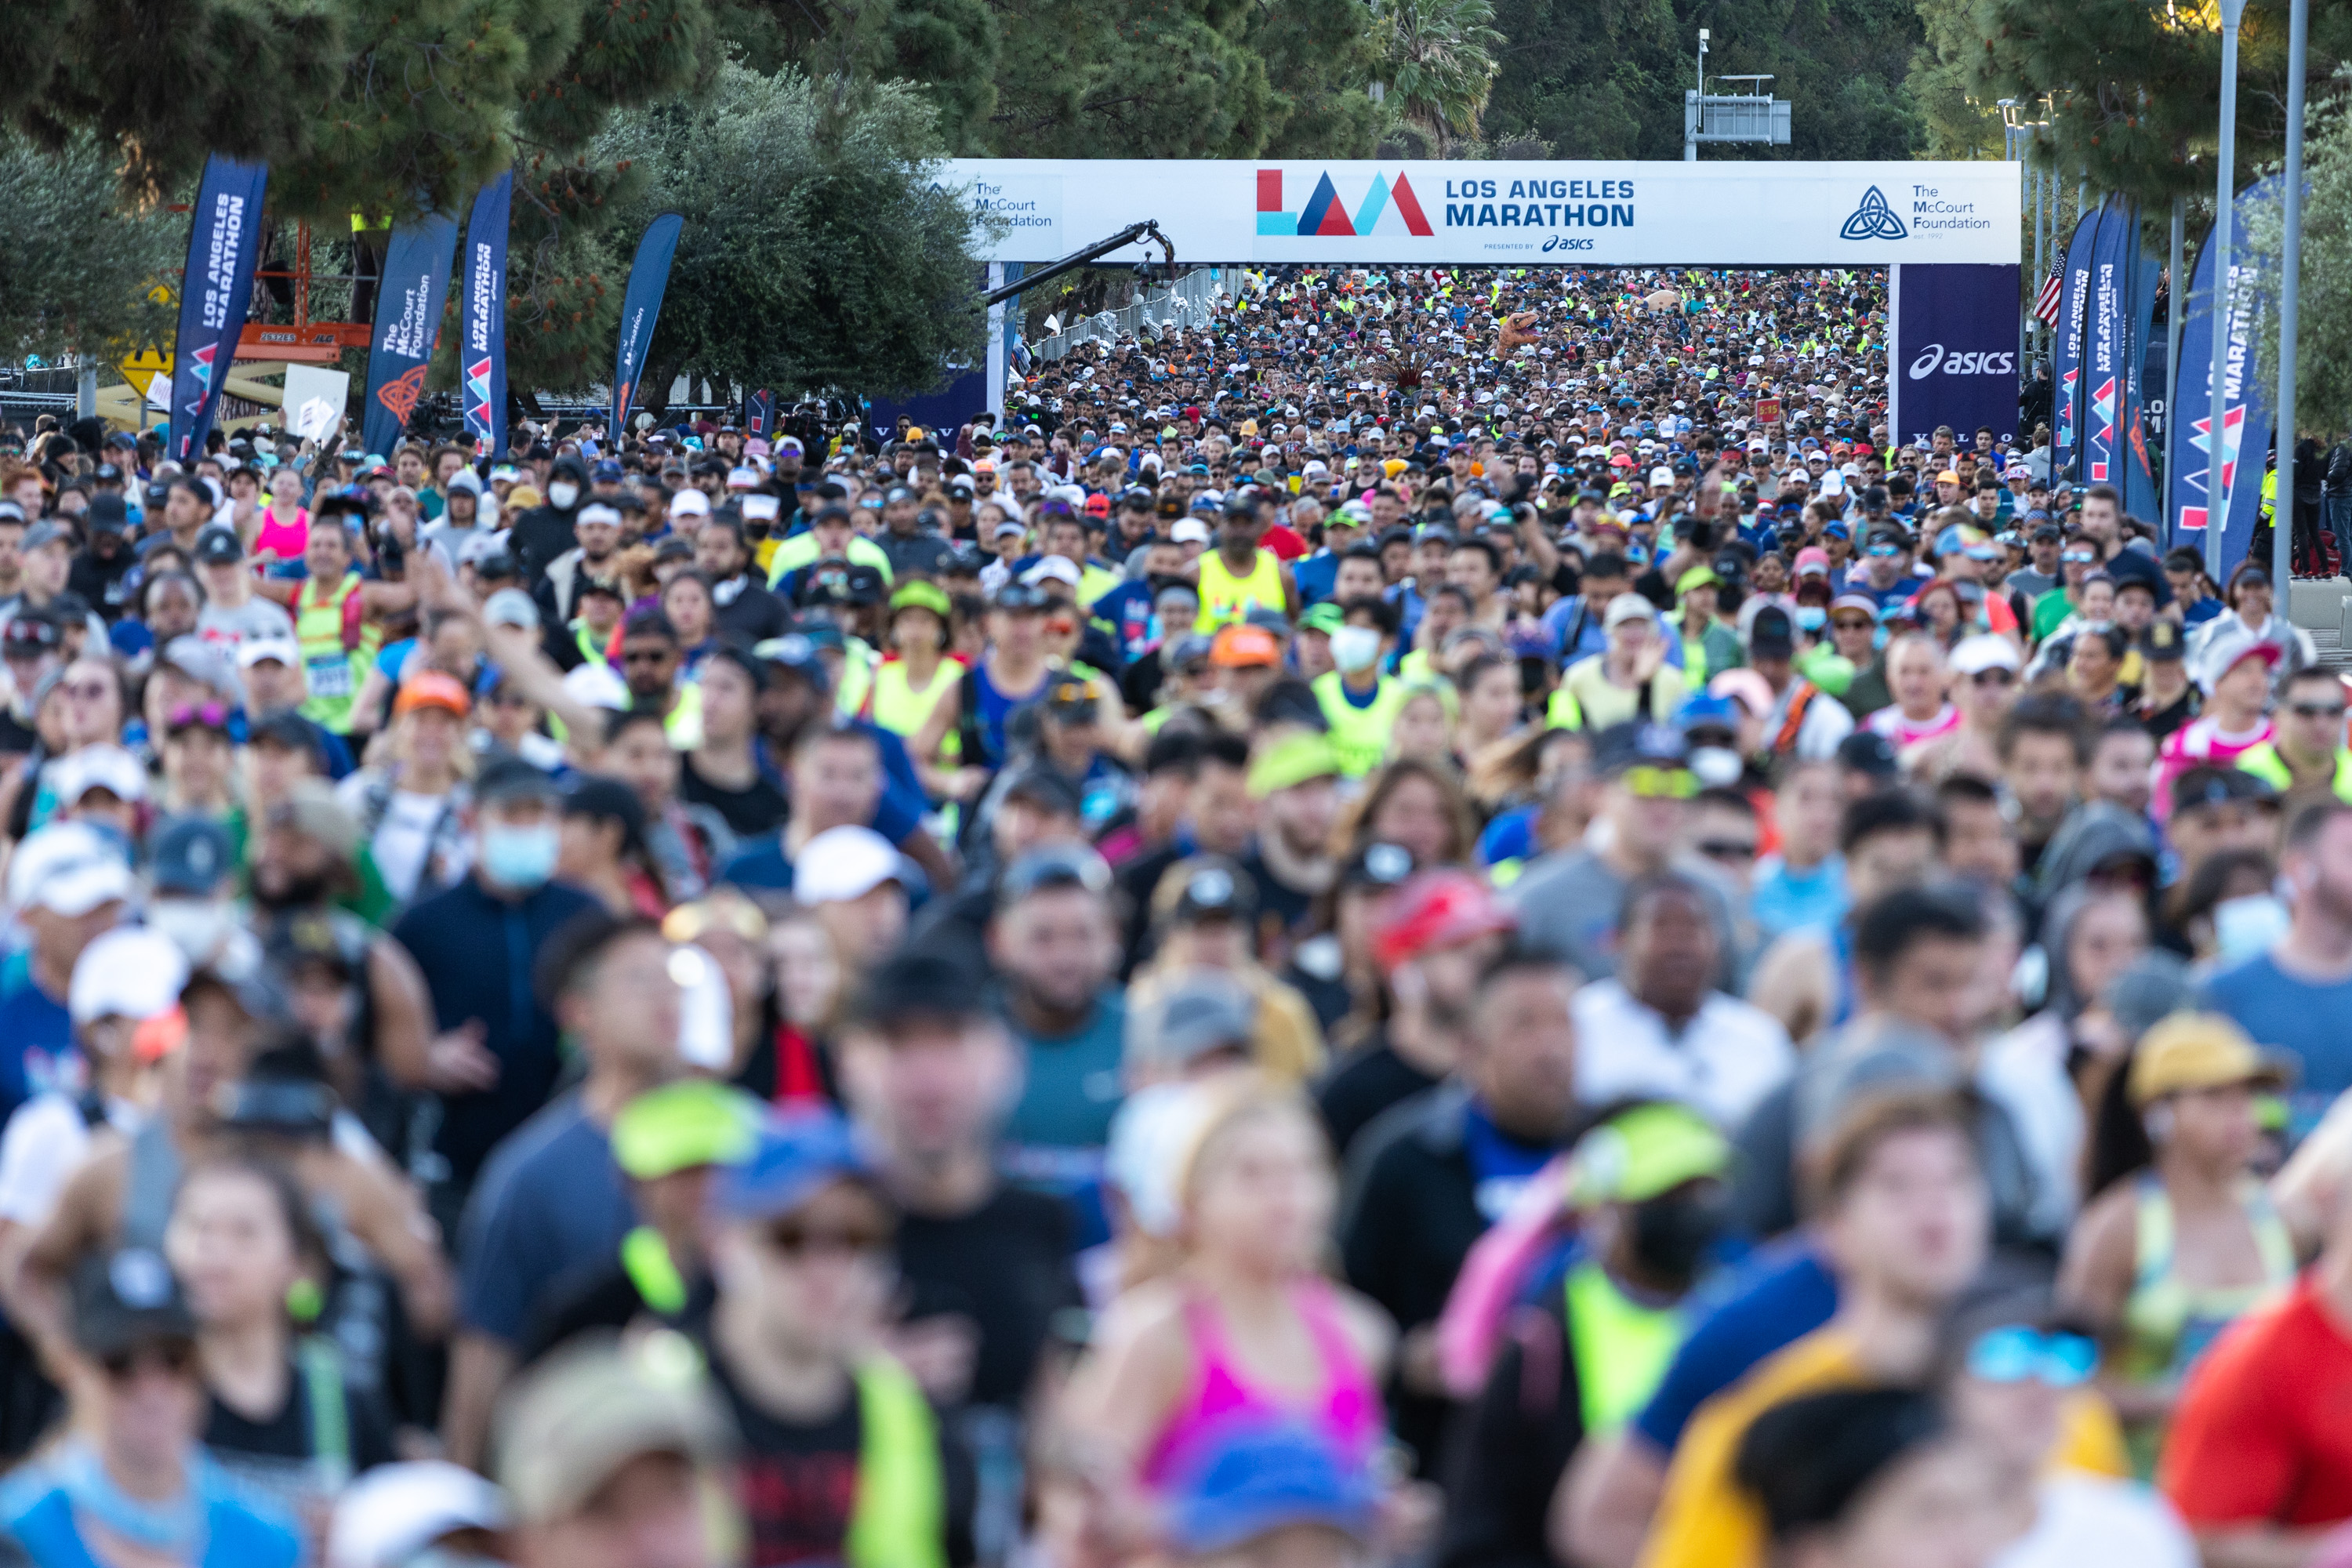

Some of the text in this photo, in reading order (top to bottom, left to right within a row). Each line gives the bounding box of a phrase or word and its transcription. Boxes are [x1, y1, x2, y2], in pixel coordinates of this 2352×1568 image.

[977, 183, 1000, 194] The
[1446, 180, 1635, 199] LOS ANGELES
[1913, 184, 1938, 197] The
[975, 198, 1036, 210] McCourt
[1446, 204, 1635, 227] MARATHON
[1914, 201, 1974, 213] McCourt
[1914, 216, 1991, 229] Foundation
[203, 193, 229, 328] LOS ANGELES
[216, 195, 244, 330] MARATHON
[474, 242, 485, 314] ANGELES
[478, 244, 492, 352] MARATHON
[396, 289, 416, 357] McCourt
[408, 274, 430, 359] Foundation
[2067, 269, 2083, 358] LOS ANGELES
[2103, 263, 2114, 372] MARATHON
[260, 333, 296, 342] 2632ES
[311, 334, 334, 343] JLG
[383, 324, 398, 353] The
[1759, 405, 1777, 415] 5:15
